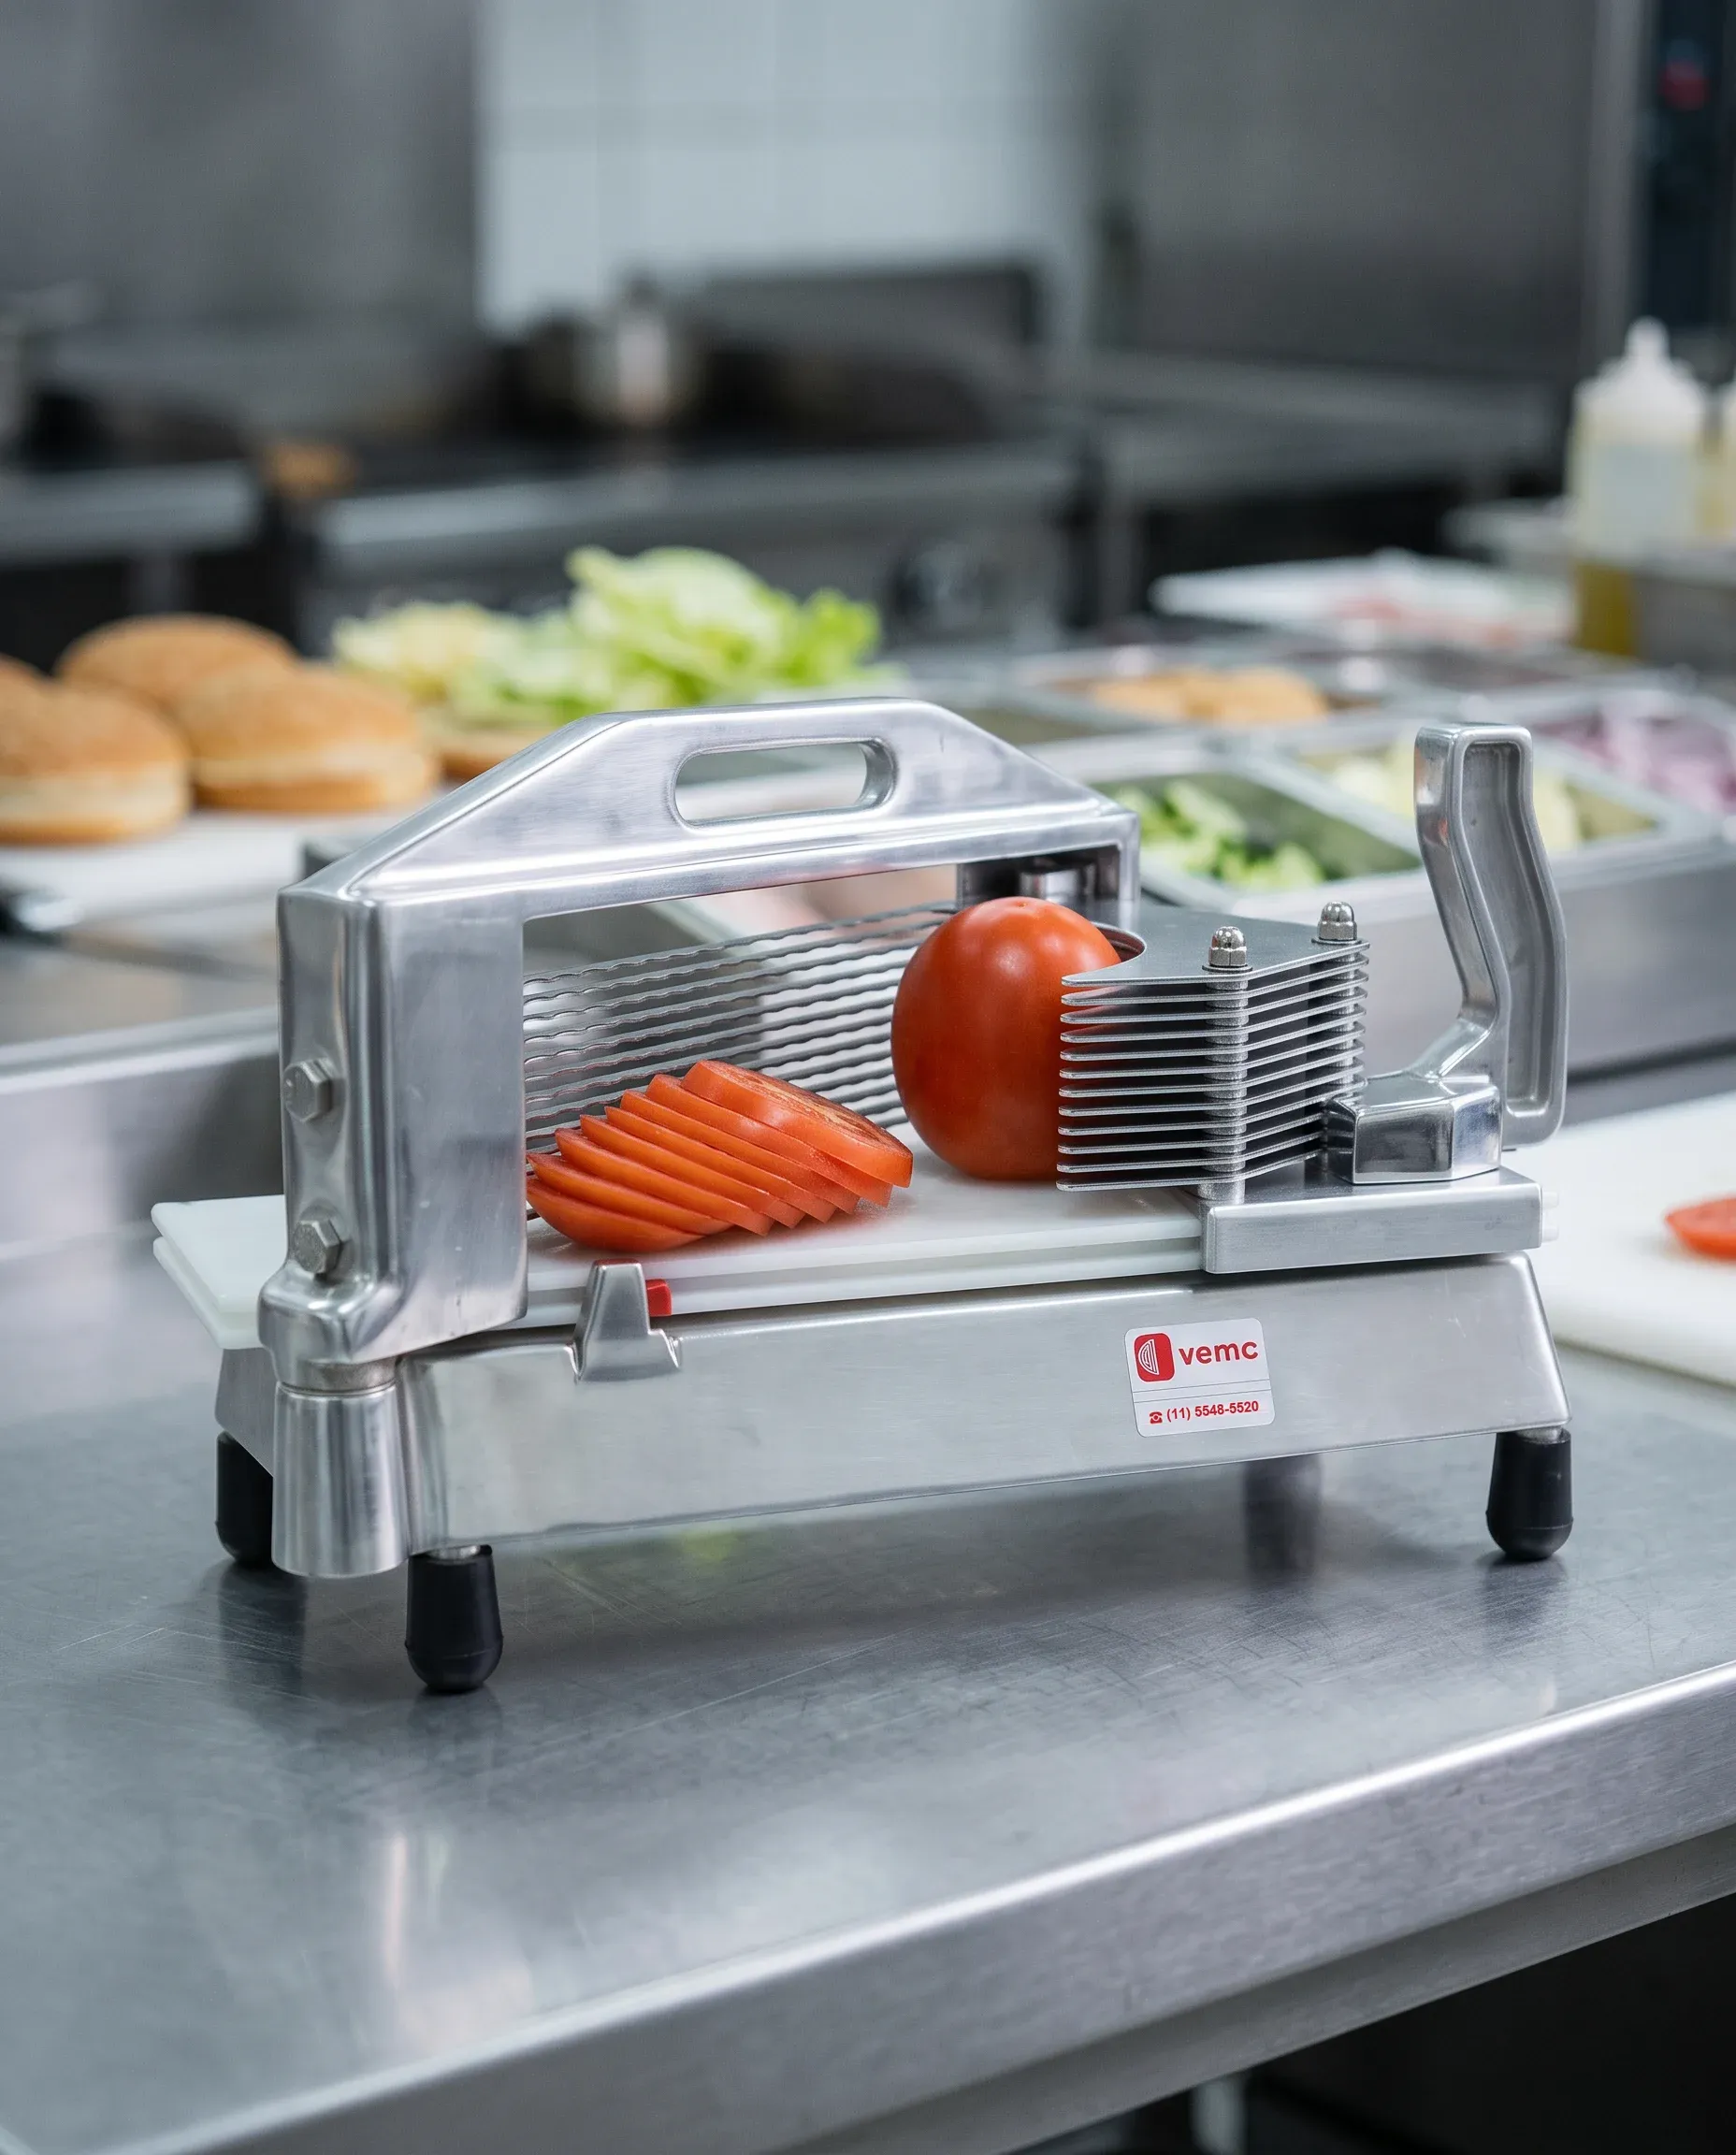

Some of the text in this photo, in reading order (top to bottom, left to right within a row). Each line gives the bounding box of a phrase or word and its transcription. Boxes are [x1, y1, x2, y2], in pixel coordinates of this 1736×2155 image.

[1179, 1341, 1258, 1366] vemc
[1166, 1400, 1259, 1423] (11) 5548-5520
